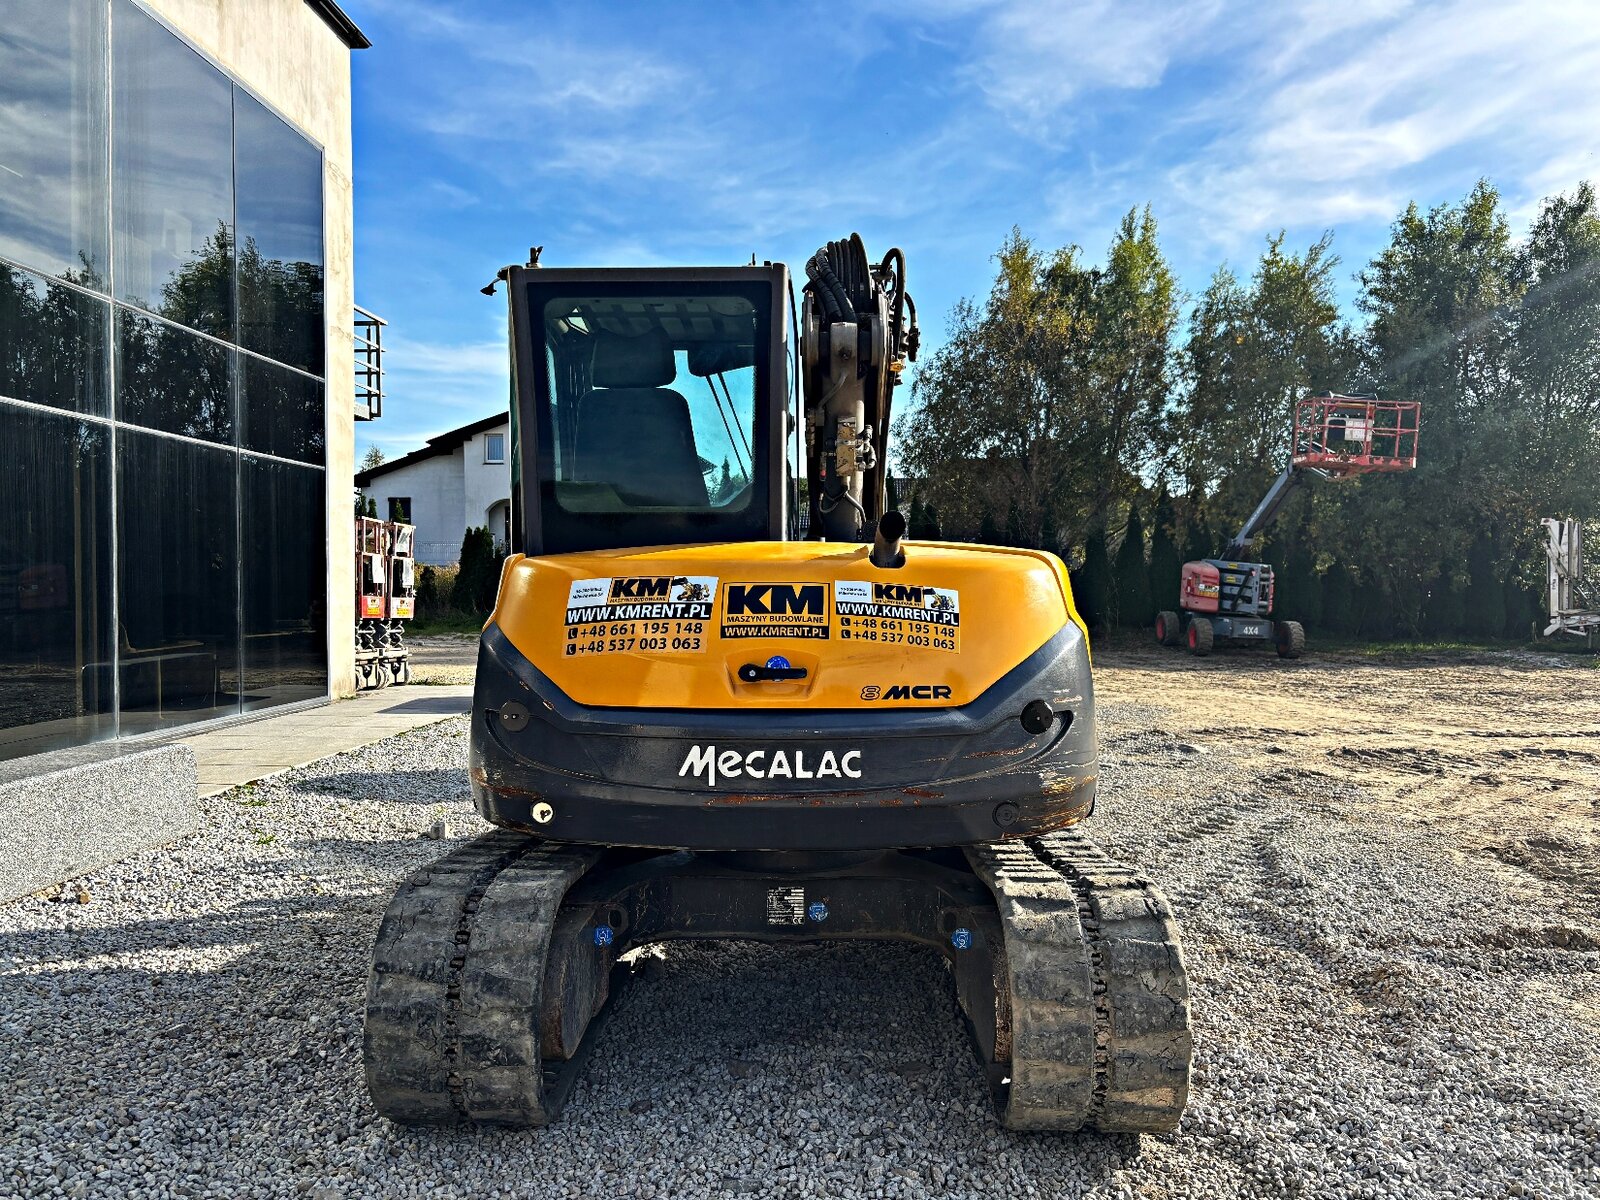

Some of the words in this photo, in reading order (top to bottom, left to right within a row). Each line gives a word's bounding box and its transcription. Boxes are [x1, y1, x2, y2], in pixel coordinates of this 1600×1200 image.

[611, 578, 671, 597] KM
[874, 584, 922, 602] KM
[727, 585, 824, 615] KM
[567, 605, 710, 623] WWW.KMRENT.PL
[727, 616, 768, 624] MASZYNY
[770, 615, 824, 624] BUDOWLANE
[837, 603, 959, 625] WWW.KMRENT.PL
[580, 626, 606, 637] +48
[610, 623, 636, 636] 661
[643, 622, 669, 634] 195
[676, 622, 703, 634] 148
[725, 627, 826, 638] WWW.KMRENT.PL
[853, 618, 877, 628] +48
[880, 620, 903, 631] 661
[908, 622, 930, 634] 195
[934, 626, 955, 638] 148
[578, 642, 604, 654] +48
[608, 638, 635, 652] 537
[639, 637, 667, 650] 003
[672, 637, 701, 650] 063
[853, 630, 877, 641] +48
[881, 632, 904, 643] 537
[907, 635, 930, 647] 003
[933, 638, 955, 650] 063
